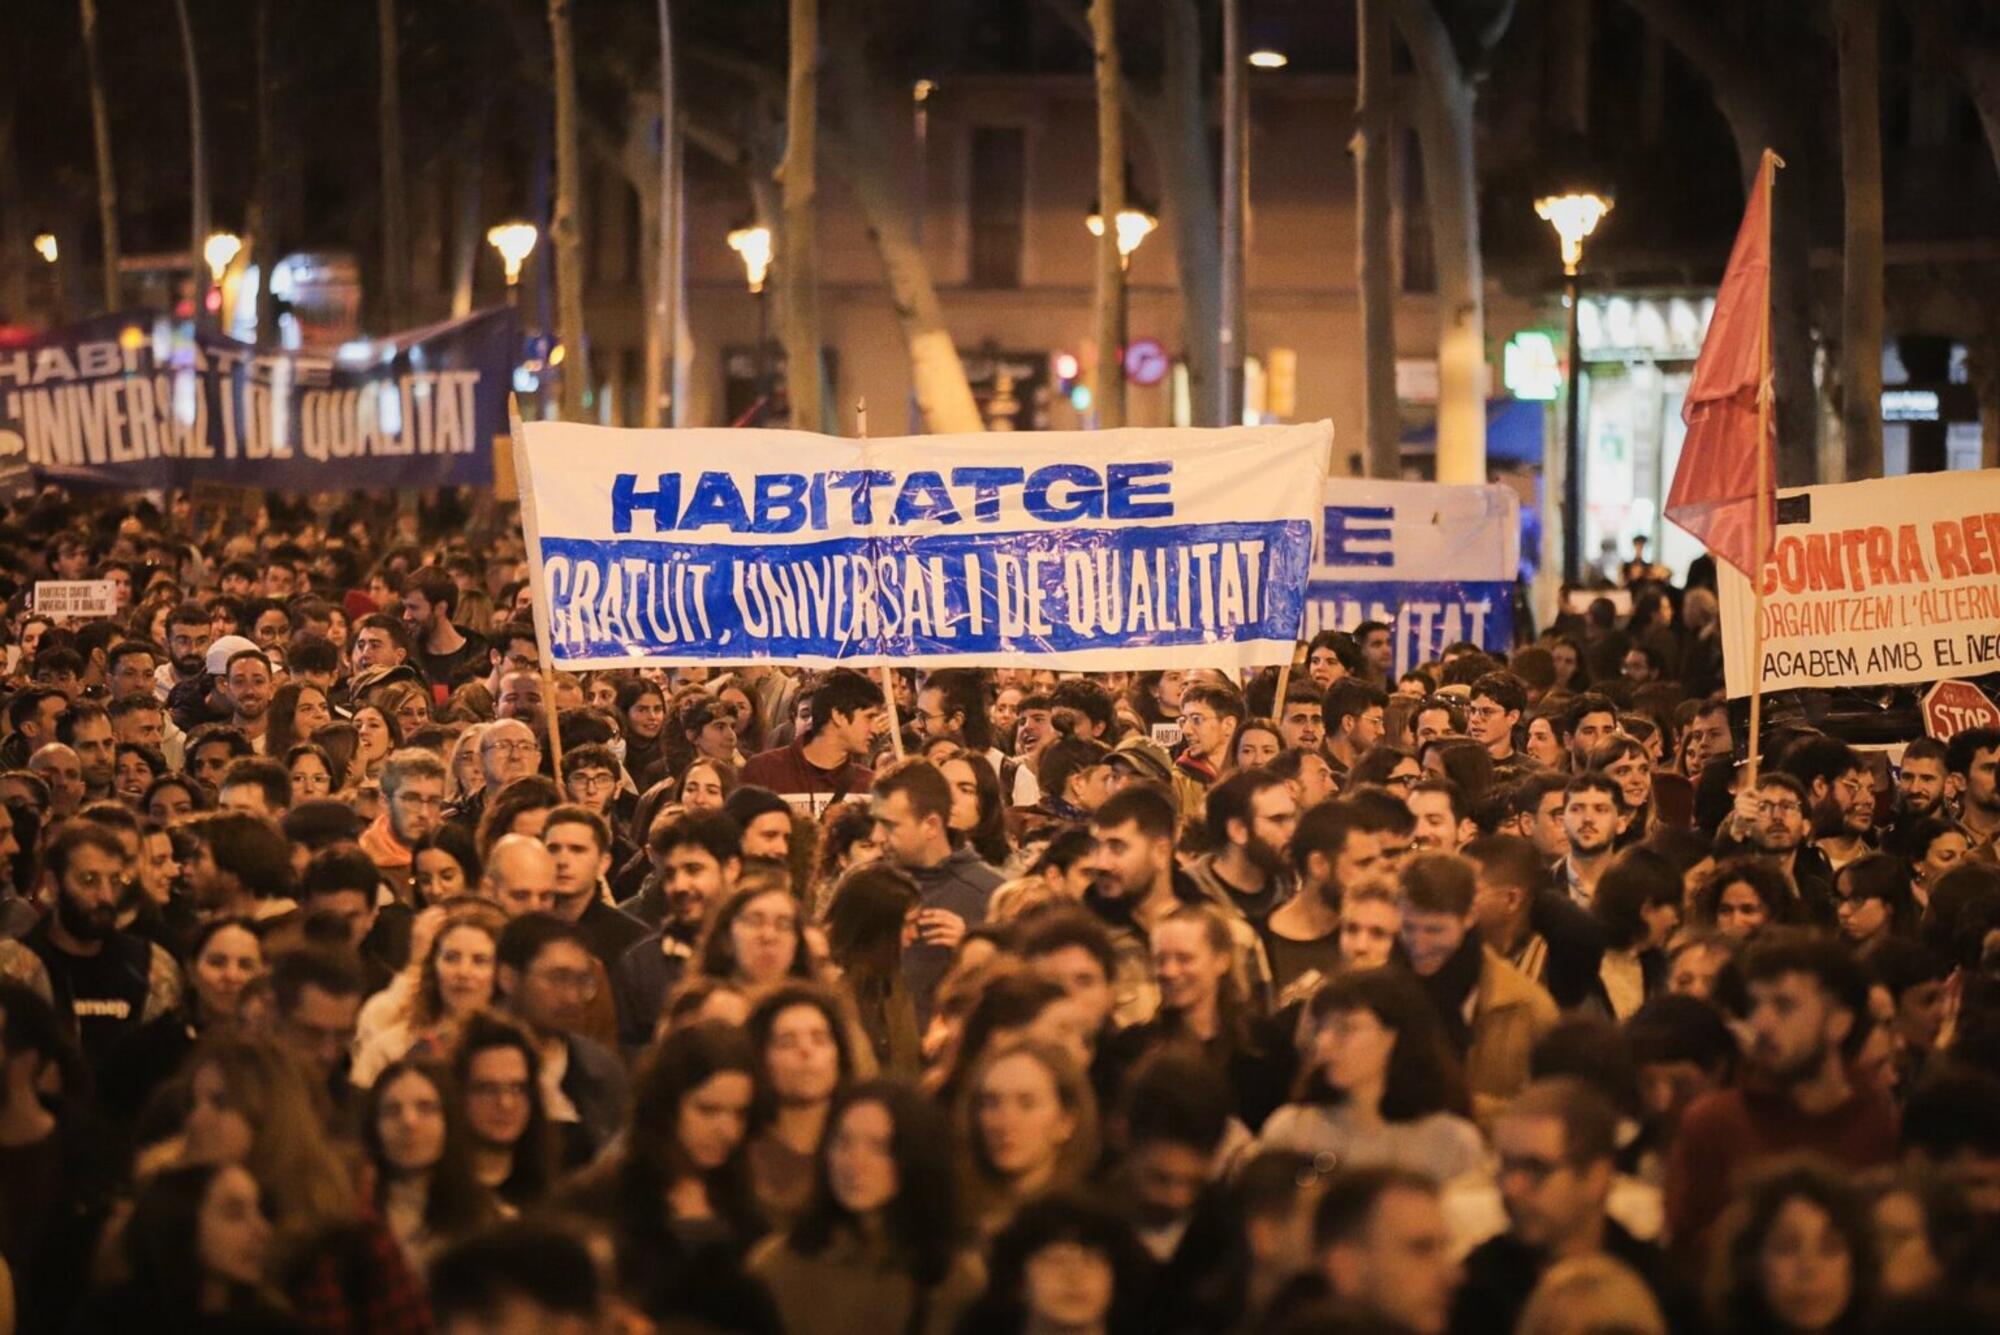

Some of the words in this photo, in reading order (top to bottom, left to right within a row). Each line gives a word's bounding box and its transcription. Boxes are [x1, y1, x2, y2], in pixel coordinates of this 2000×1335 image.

[0, 337, 332, 386] HABITGE
[612, 461, 1174, 534] HABITATGE
[733, 554, 957, 641] UNIVERSAL
[965, 553, 982, 636] I
[998, 554, 1053, 638] DE
[1065, 540, 1264, 639] QUALITAT
[1762, 647, 1859, 682] ACABEM
[1867, 641, 1922, 672] AMB
[1934, 638, 1962, 667] EL
[1935, 703, 1991, 743] STOP
